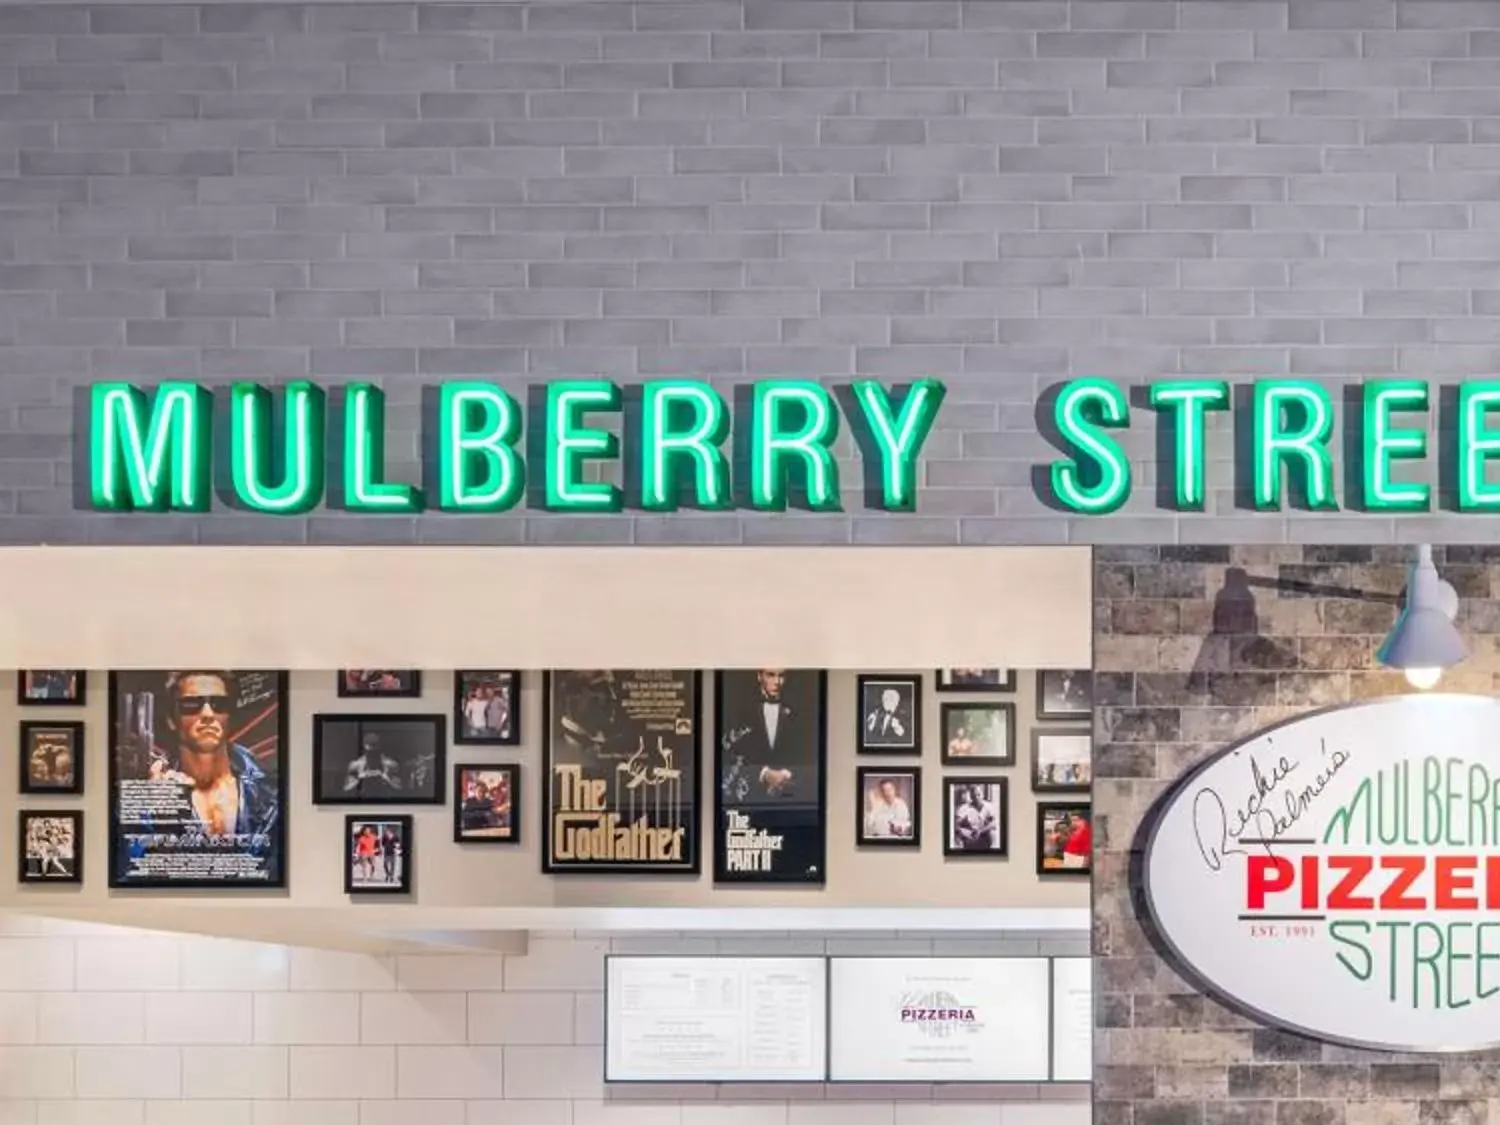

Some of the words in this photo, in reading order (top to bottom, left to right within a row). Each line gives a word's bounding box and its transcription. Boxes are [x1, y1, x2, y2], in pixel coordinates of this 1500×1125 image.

[90, 380, 946, 512] MULBERRY
[554, 764, 607, 811] The
[726, 810, 750, 829] The
[555, 812, 685, 861] Godfather
[727, 829, 784, 850] Godfather
[727, 850, 761, 871] PART
[761, 850, 771, 871] II
[901, 1009, 975, 1020] PIZZERIA
